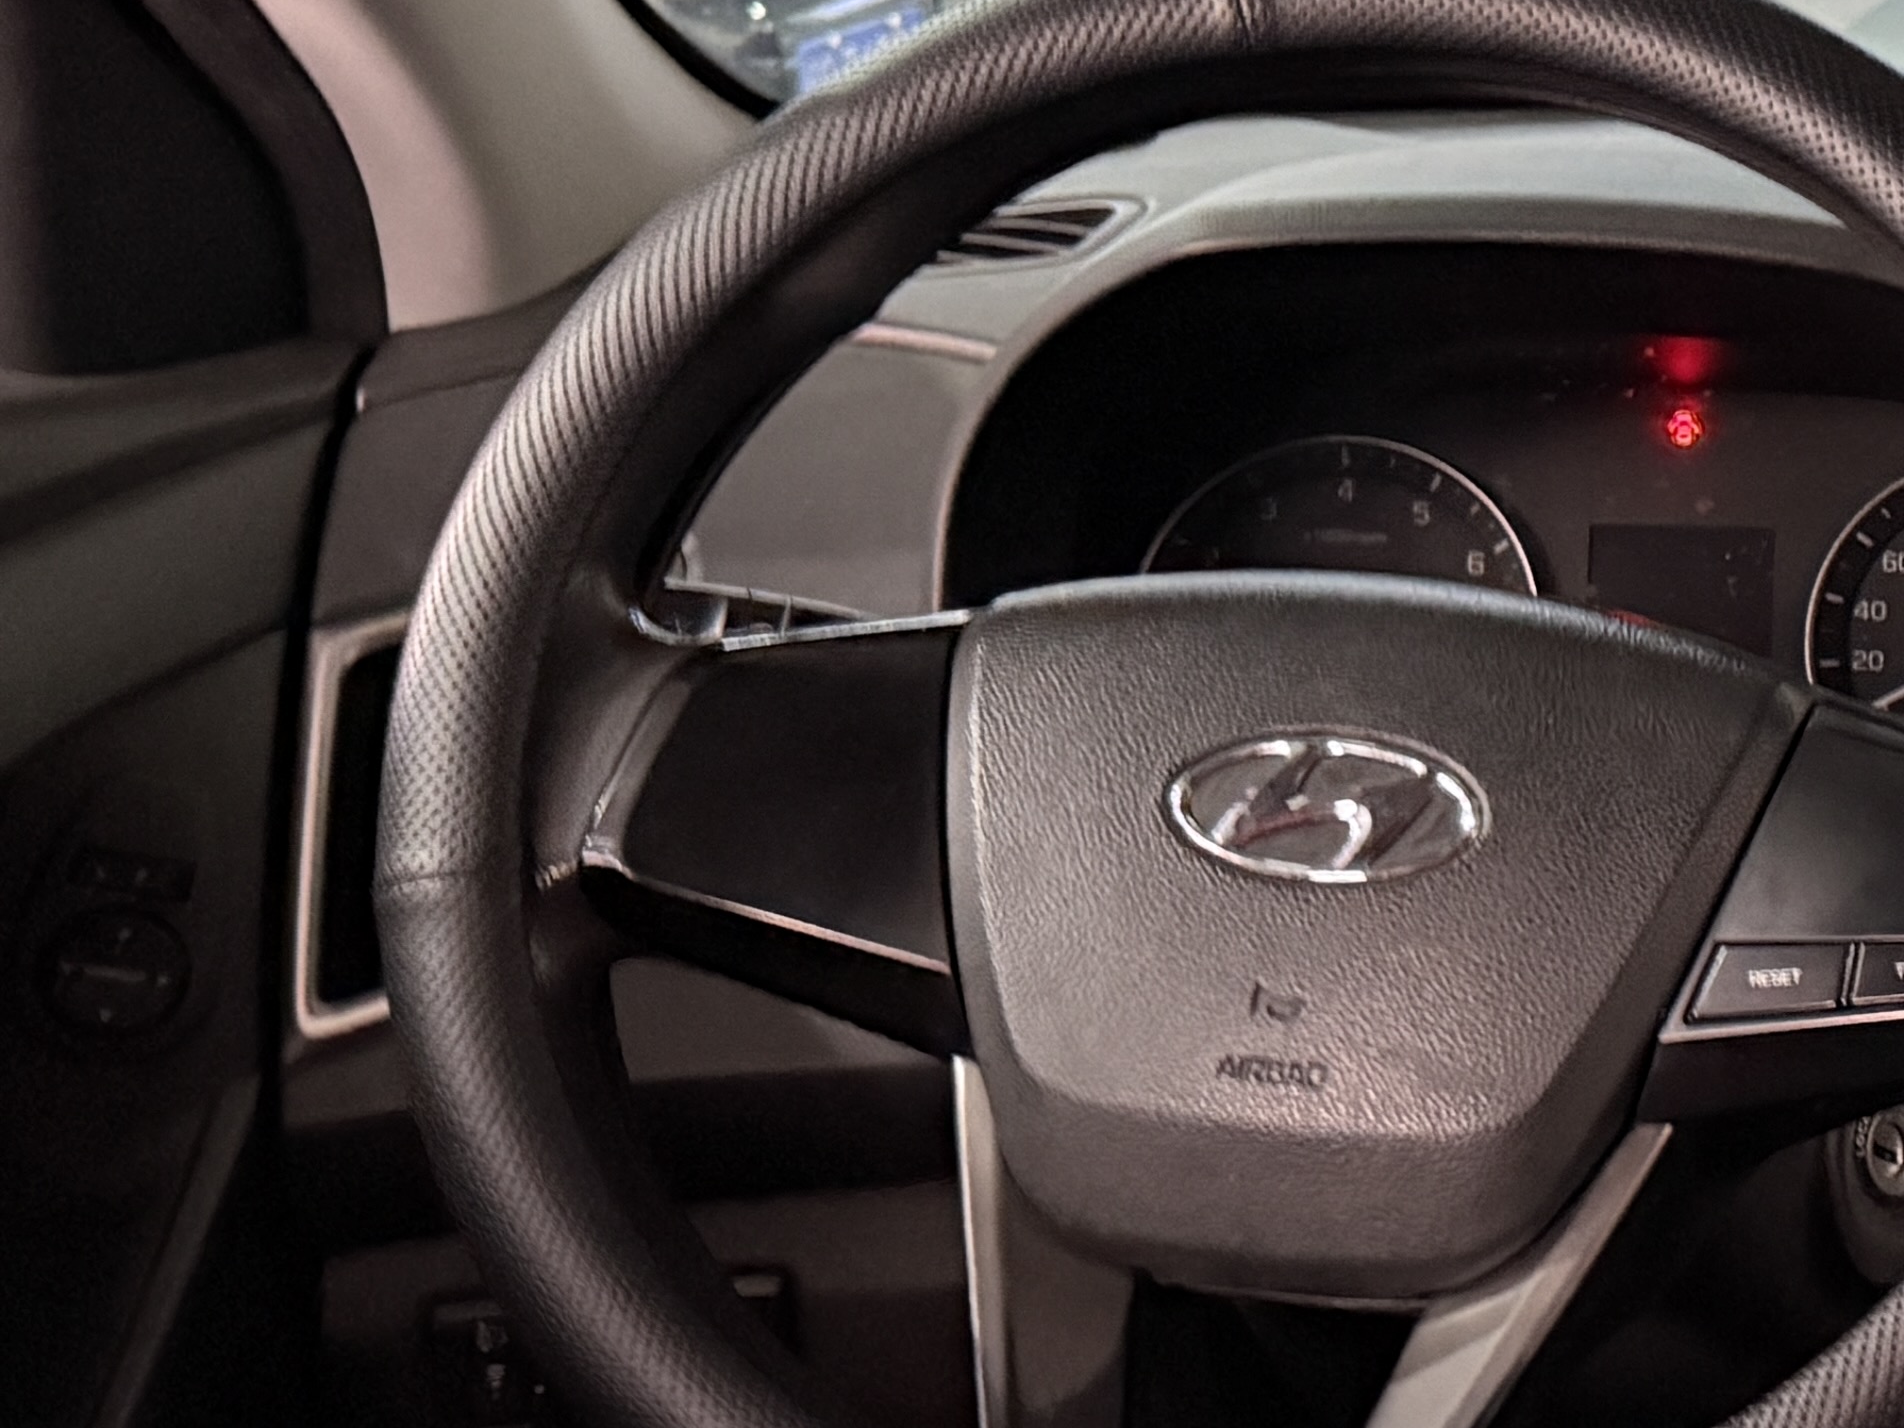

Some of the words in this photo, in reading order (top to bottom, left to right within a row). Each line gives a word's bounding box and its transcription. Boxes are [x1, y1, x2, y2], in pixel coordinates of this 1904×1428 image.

[1854, 600, 1887, 622] 40
[1852, 650, 1884, 672] 20
[1747, 967, 1803, 989] RESET
[1215, 1054, 1330, 1091] AIRBAG
